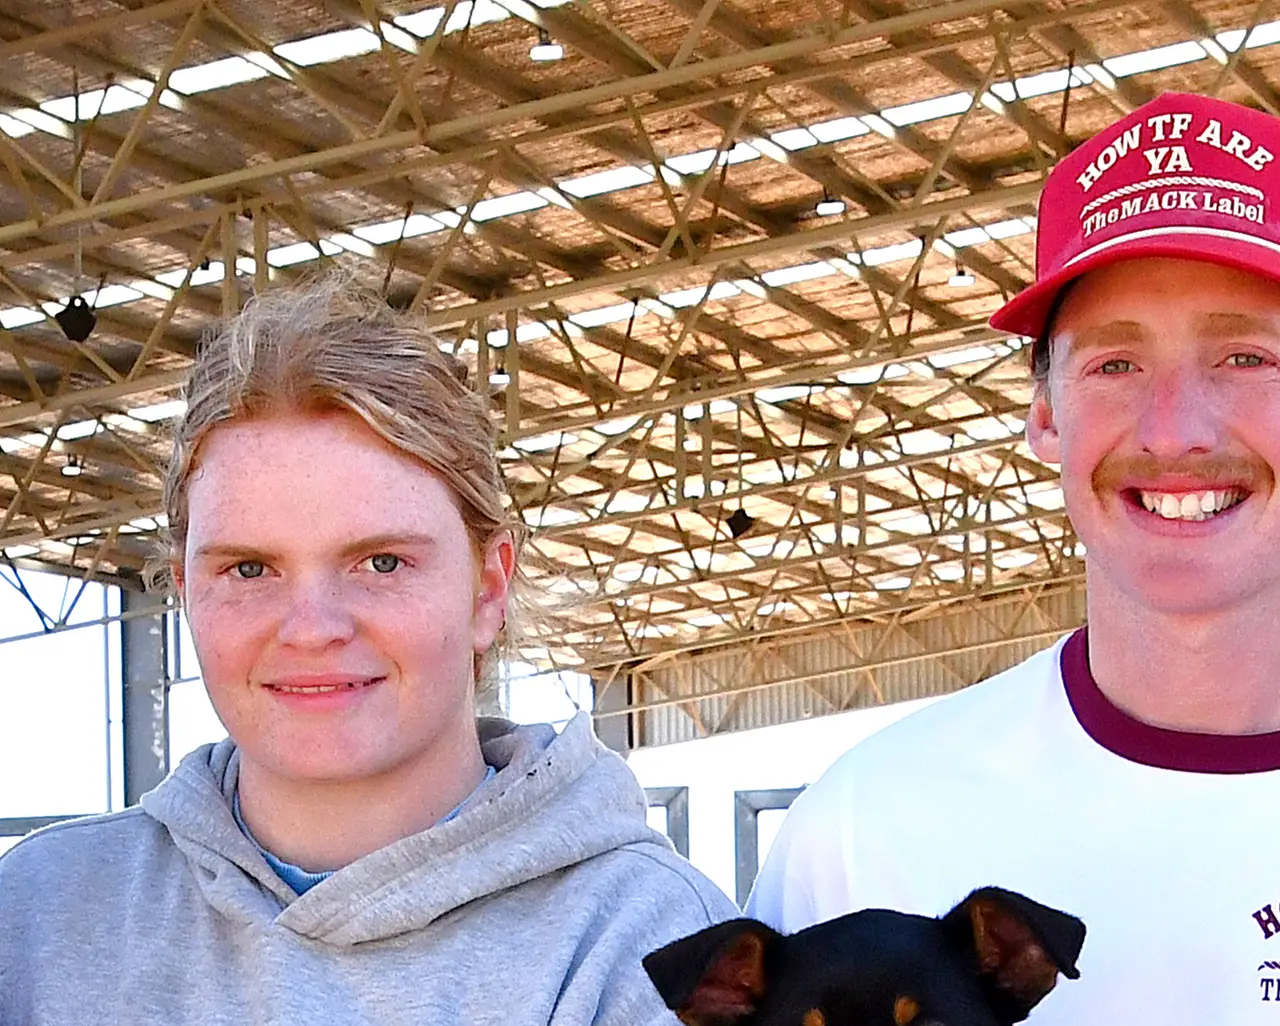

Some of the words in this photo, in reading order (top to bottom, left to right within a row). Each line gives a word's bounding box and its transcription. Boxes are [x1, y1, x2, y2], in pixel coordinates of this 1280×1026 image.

[1076, 123, 1142, 193] HOW
[1147, 113, 1193, 143] TF
[1196, 119, 1275, 172] ARE
[1143, 146, 1193, 175] YA
[1202, 191, 1265, 225] Label
